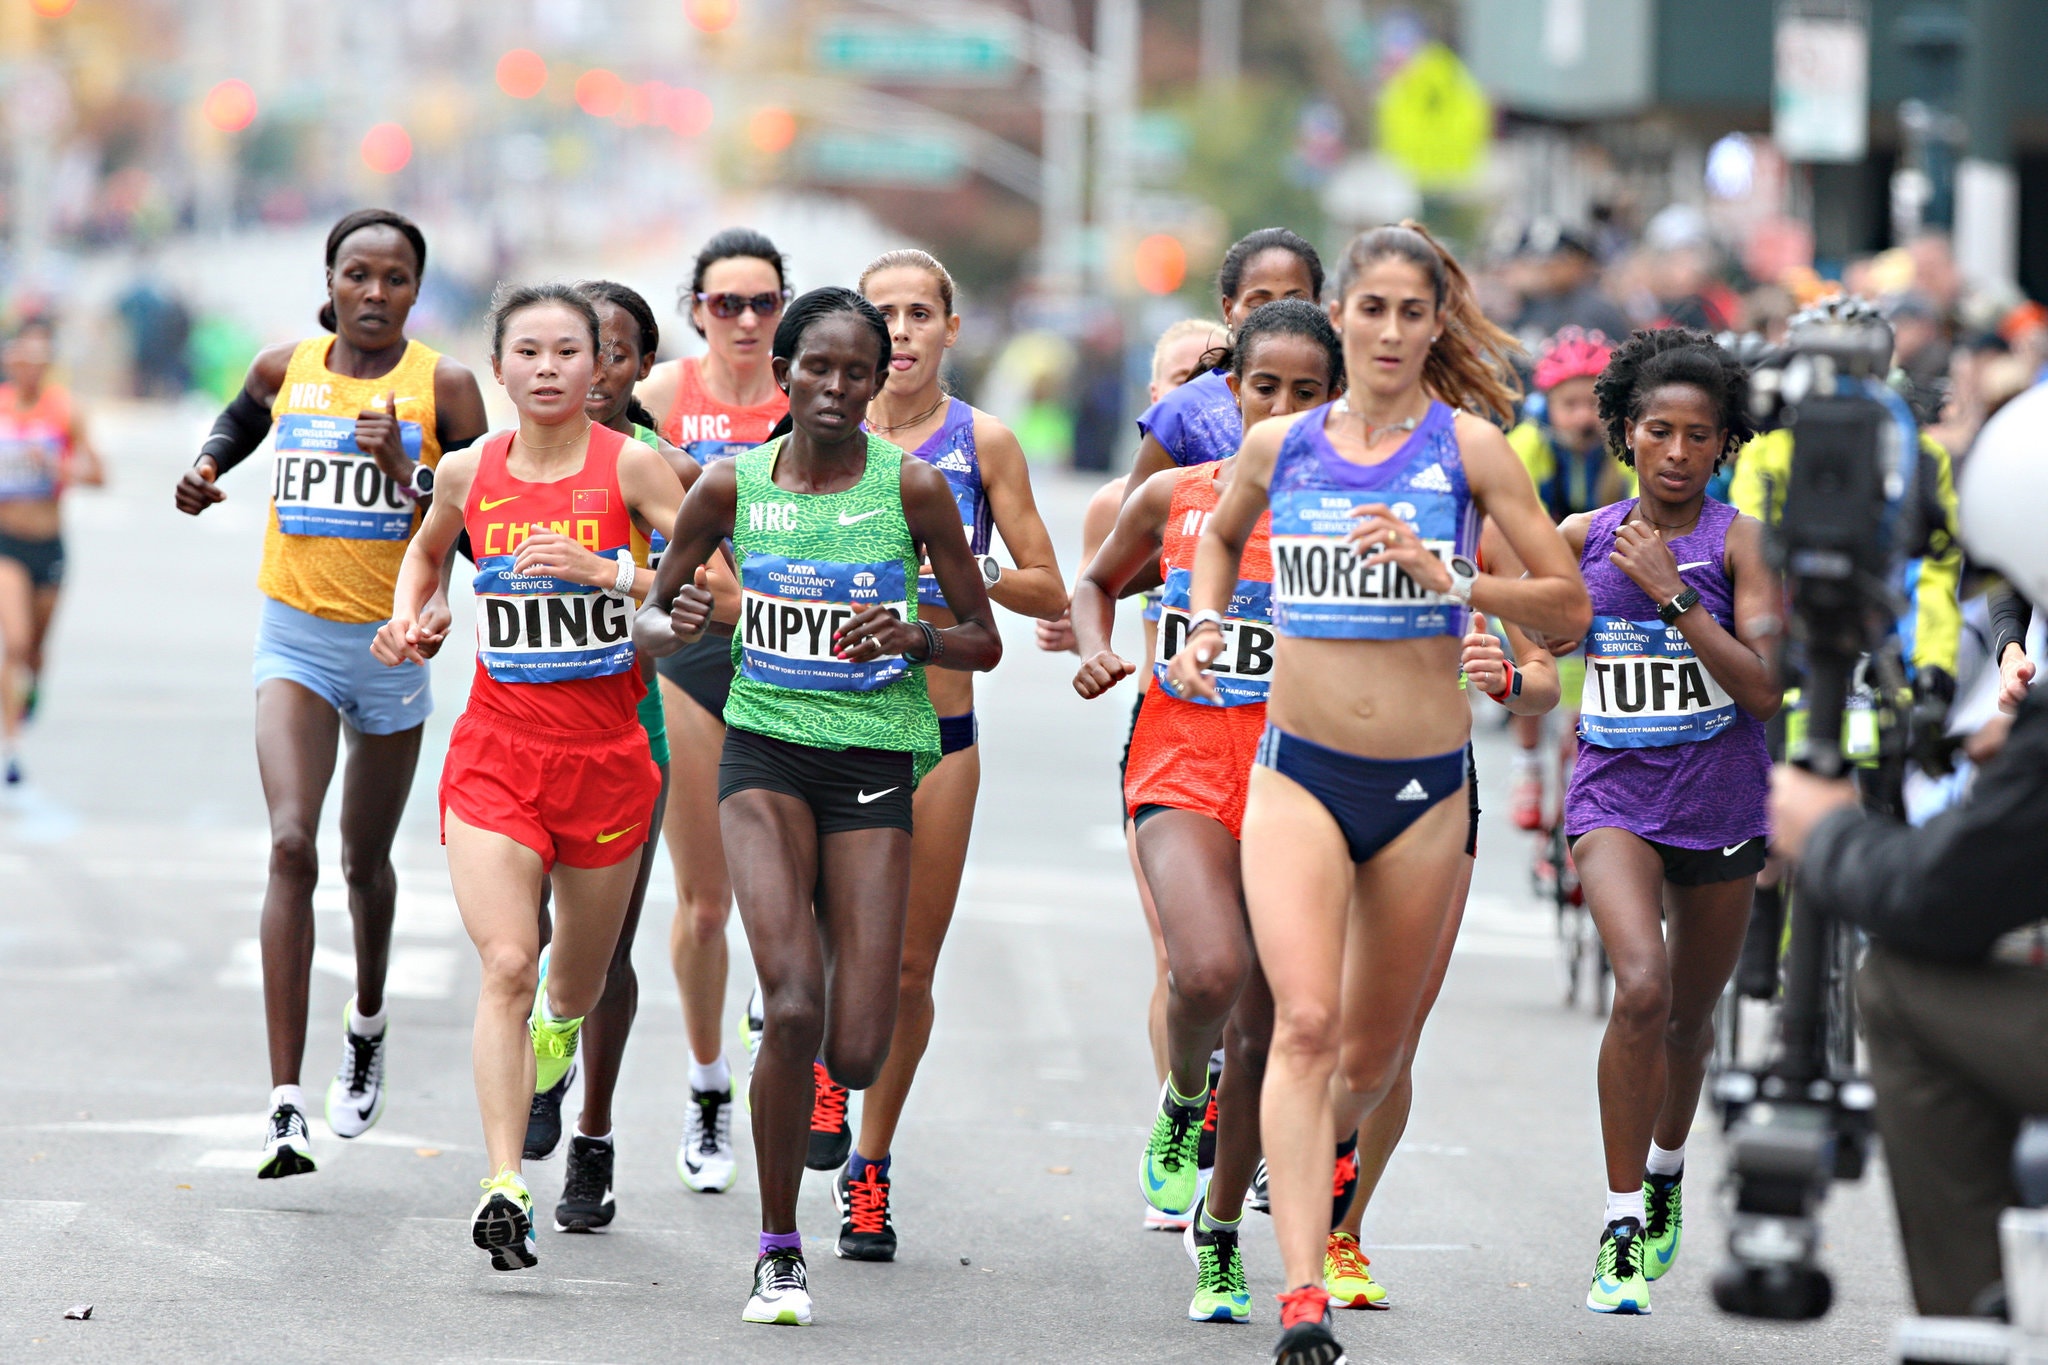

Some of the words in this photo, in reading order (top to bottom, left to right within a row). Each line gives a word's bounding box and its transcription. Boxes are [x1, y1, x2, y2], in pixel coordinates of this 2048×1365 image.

[288, 382, 332, 410] NRC
[681, 413, 732, 441] NRC
[936, 459, 972, 473] adidas
[750, 502, 798, 531] NRC
[484, 519, 600, 555] CHNA
[786, 564, 816, 575] TATA
[510, 580, 553, 590] SERVICES
[768, 571, 835, 588] CONSULTANCY
[779, 584, 823, 597] SERVICES
[849, 588, 878, 598] TATA
[486, 594, 629, 648] DING
[746, 597, 901, 657] KIPYE
[1606, 621, 1634, 631] TATA
[1594, 632, 1650, 643] CONSULTANCY
[1602, 643, 1644, 652] SERVICES
[1664, 641, 1692, 651] TATA
[492, 661, 505, 669] TCS
[537, 661, 551, 669] CITY
[552, 660, 587, 668] MARATHON
[753, 659, 767, 668] TCS
[781, 667, 796, 675] YORK
[797, 668, 812, 676] CITY
[813, 671, 849, 679] MARATHON
[1225, 688, 1260, 697] MARATHON
[1594, 662, 1711, 713] TUFA
[1628, 725, 1641, 733] CITY
[1642, 725, 1677, 733] MARATHON
